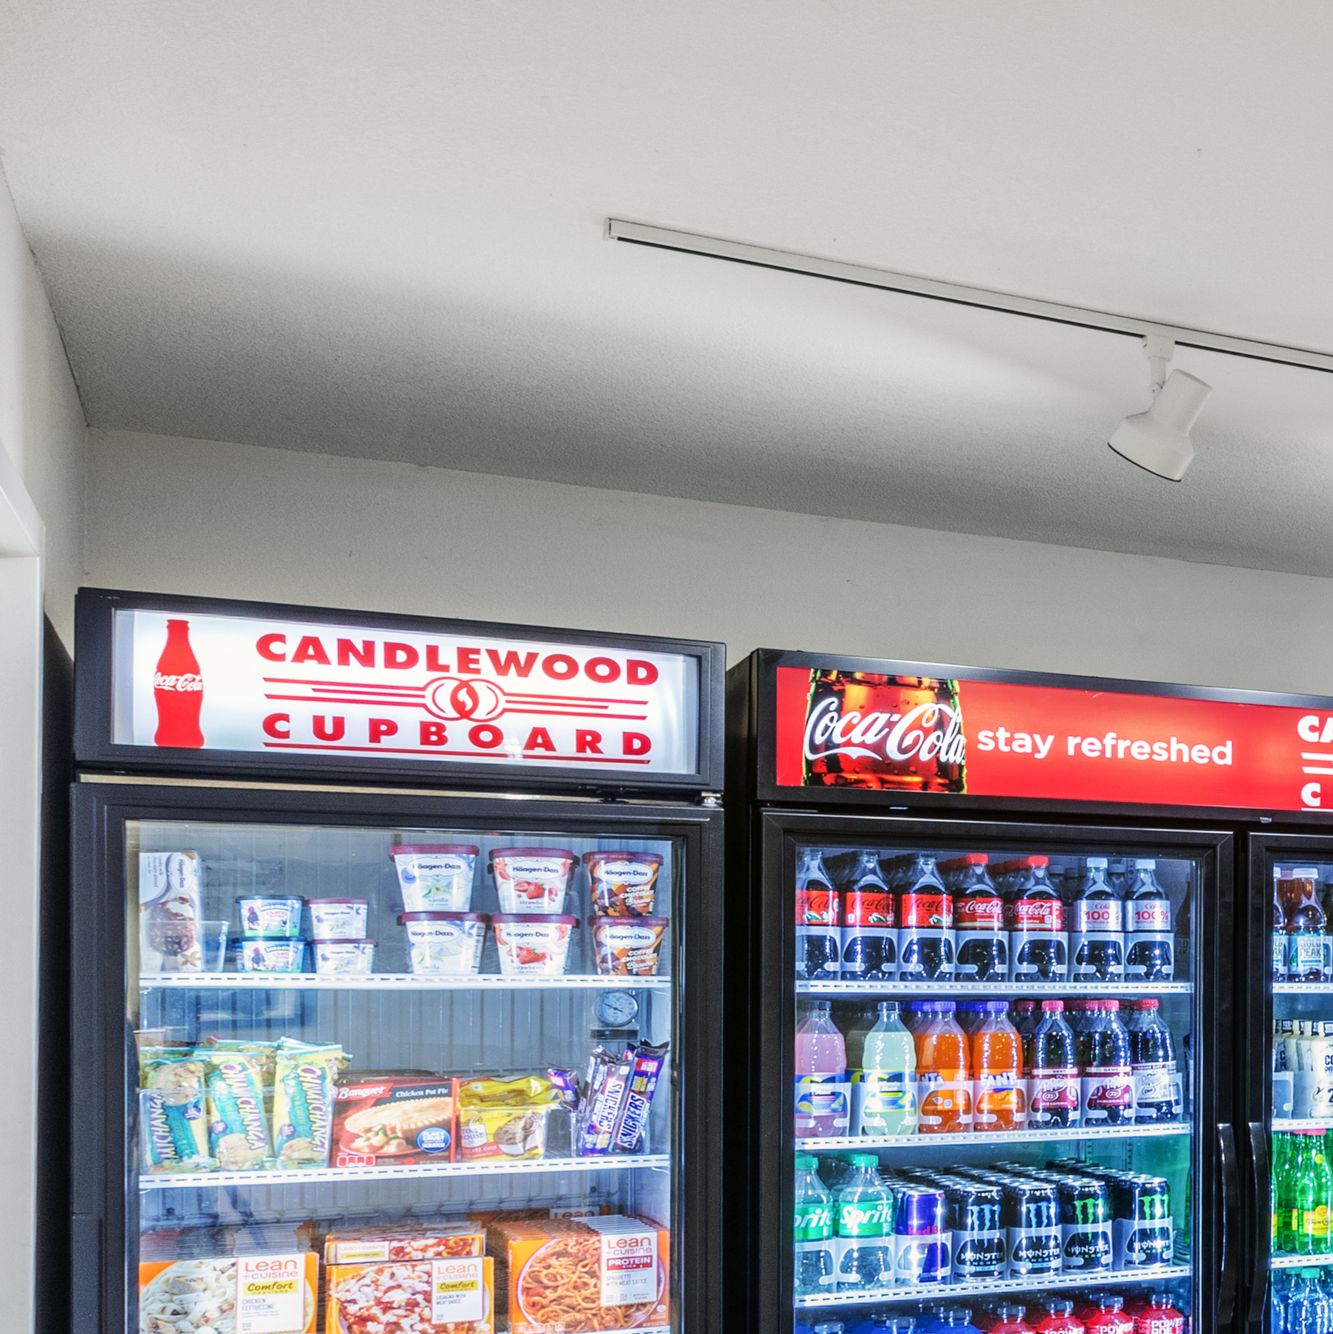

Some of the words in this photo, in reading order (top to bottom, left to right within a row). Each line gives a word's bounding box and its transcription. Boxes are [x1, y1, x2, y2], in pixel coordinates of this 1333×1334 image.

[255, 632, 660, 686] CANDLEWOOD
[261, 712, 653, 756] CUPBOARD
[804, 696, 967, 766] Coca-Cola
[977, 732, 1055, 763] stay
[1066, 729, 1234, 767] refreshed
[338, 1086, 386, 1100] Banquet
[618, 1094, 646, 1149] SNICKERS
[607, 1237, 651, 1249] Lean
[245, 1259, 298, 1272] Lean
[608, 1257, 651, 1266] PROTEIN
[437, 1263, 477, 1274] Lean
[247, 1281, 293, 1292] Comfort
[439, 1281, 475, 1289] Comfort
